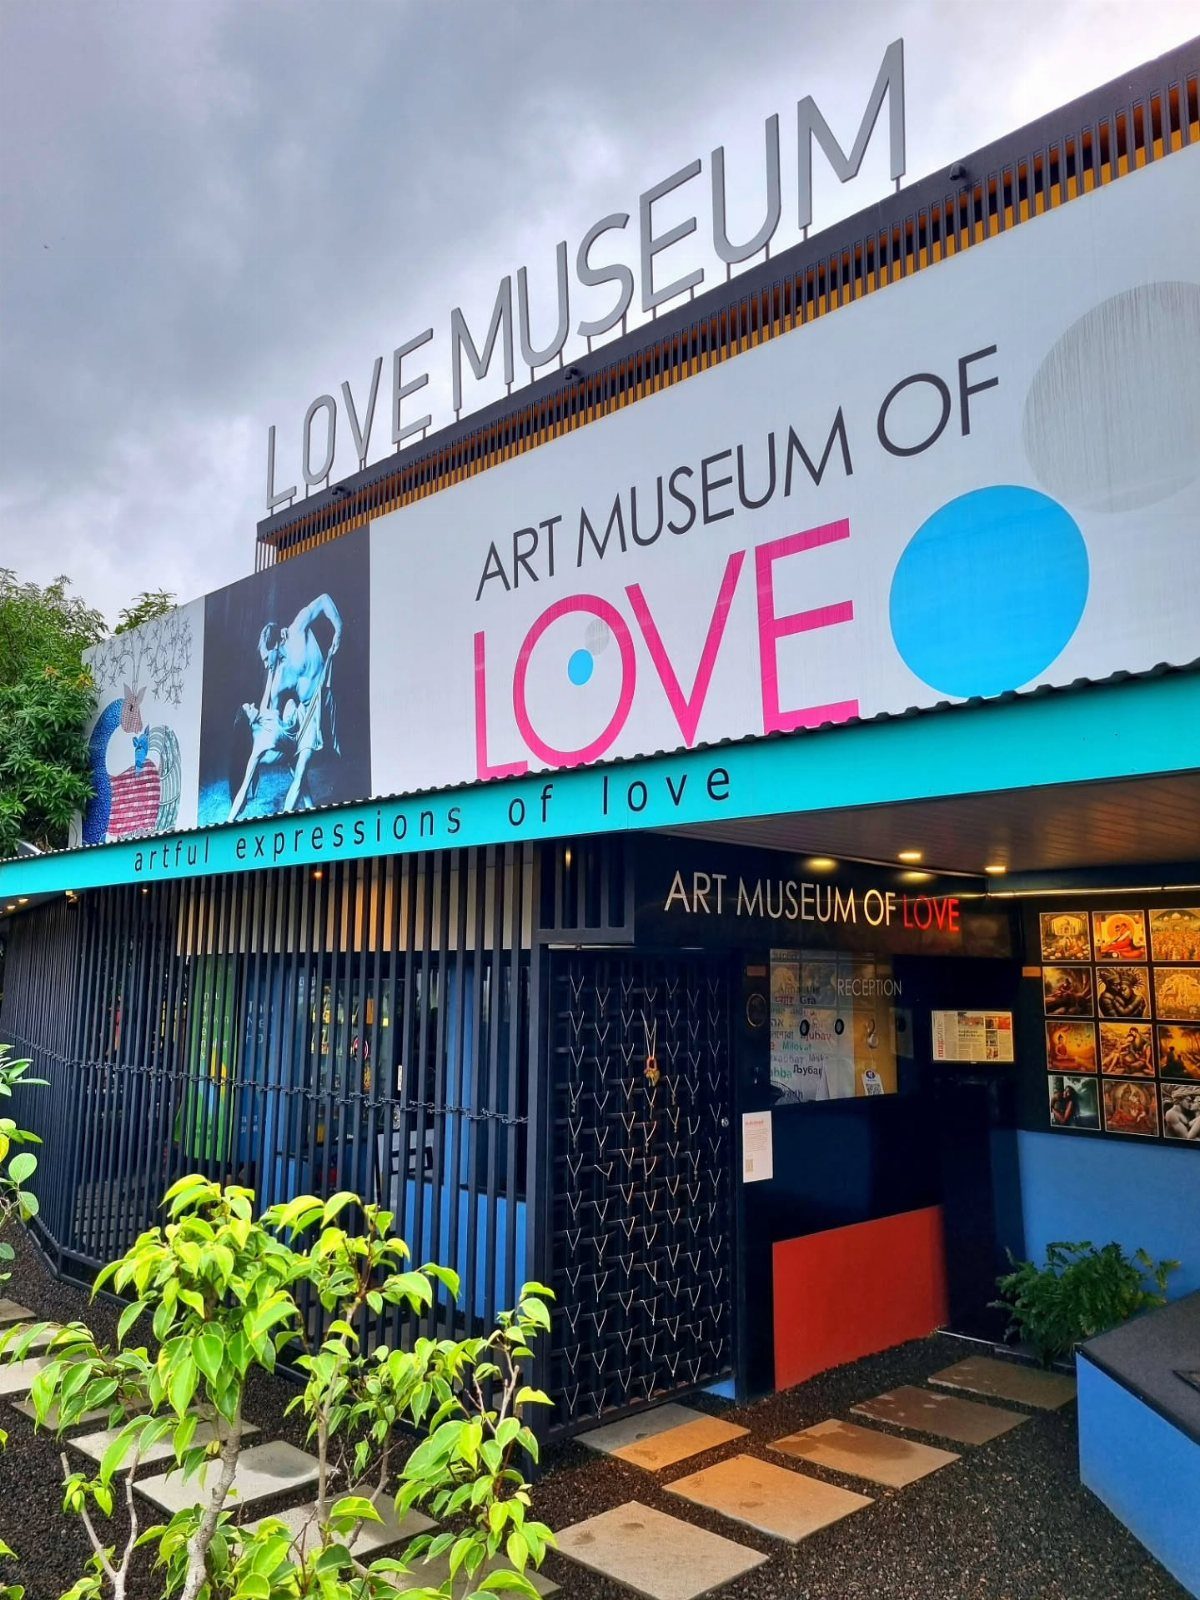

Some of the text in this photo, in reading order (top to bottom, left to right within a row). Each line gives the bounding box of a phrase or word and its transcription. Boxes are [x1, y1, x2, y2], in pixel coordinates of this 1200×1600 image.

[266, 37, 906, 509] LOVE MUSEUM
[476, 344, 1000, 602] ART MUSEUM OF
[473, 517, 860, 780] LOVE
[133, 766, 732, 872] artful expressions of love
[664, 870, 961, 933] ART MUSEUM OF LOVE
[837, 978, 903, 997] RECEPTION
